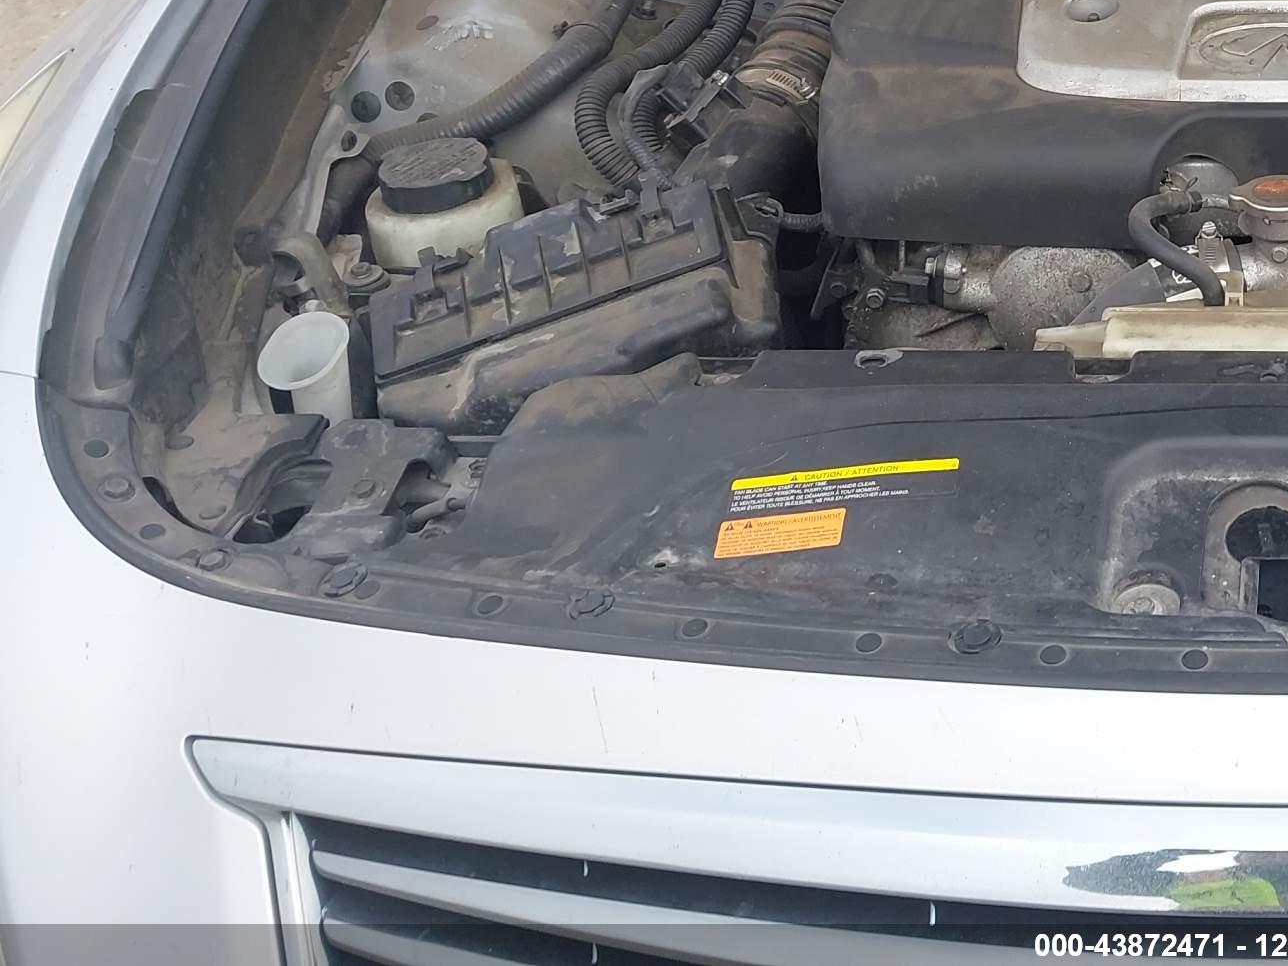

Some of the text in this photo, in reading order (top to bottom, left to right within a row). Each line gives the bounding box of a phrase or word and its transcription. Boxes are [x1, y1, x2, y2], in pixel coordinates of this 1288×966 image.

[804, 472, 842, 480] CAUTION
[852, 466, 898, 475] ATTENTION
[792, 513, 841, 524] AVERTISSEMENT
